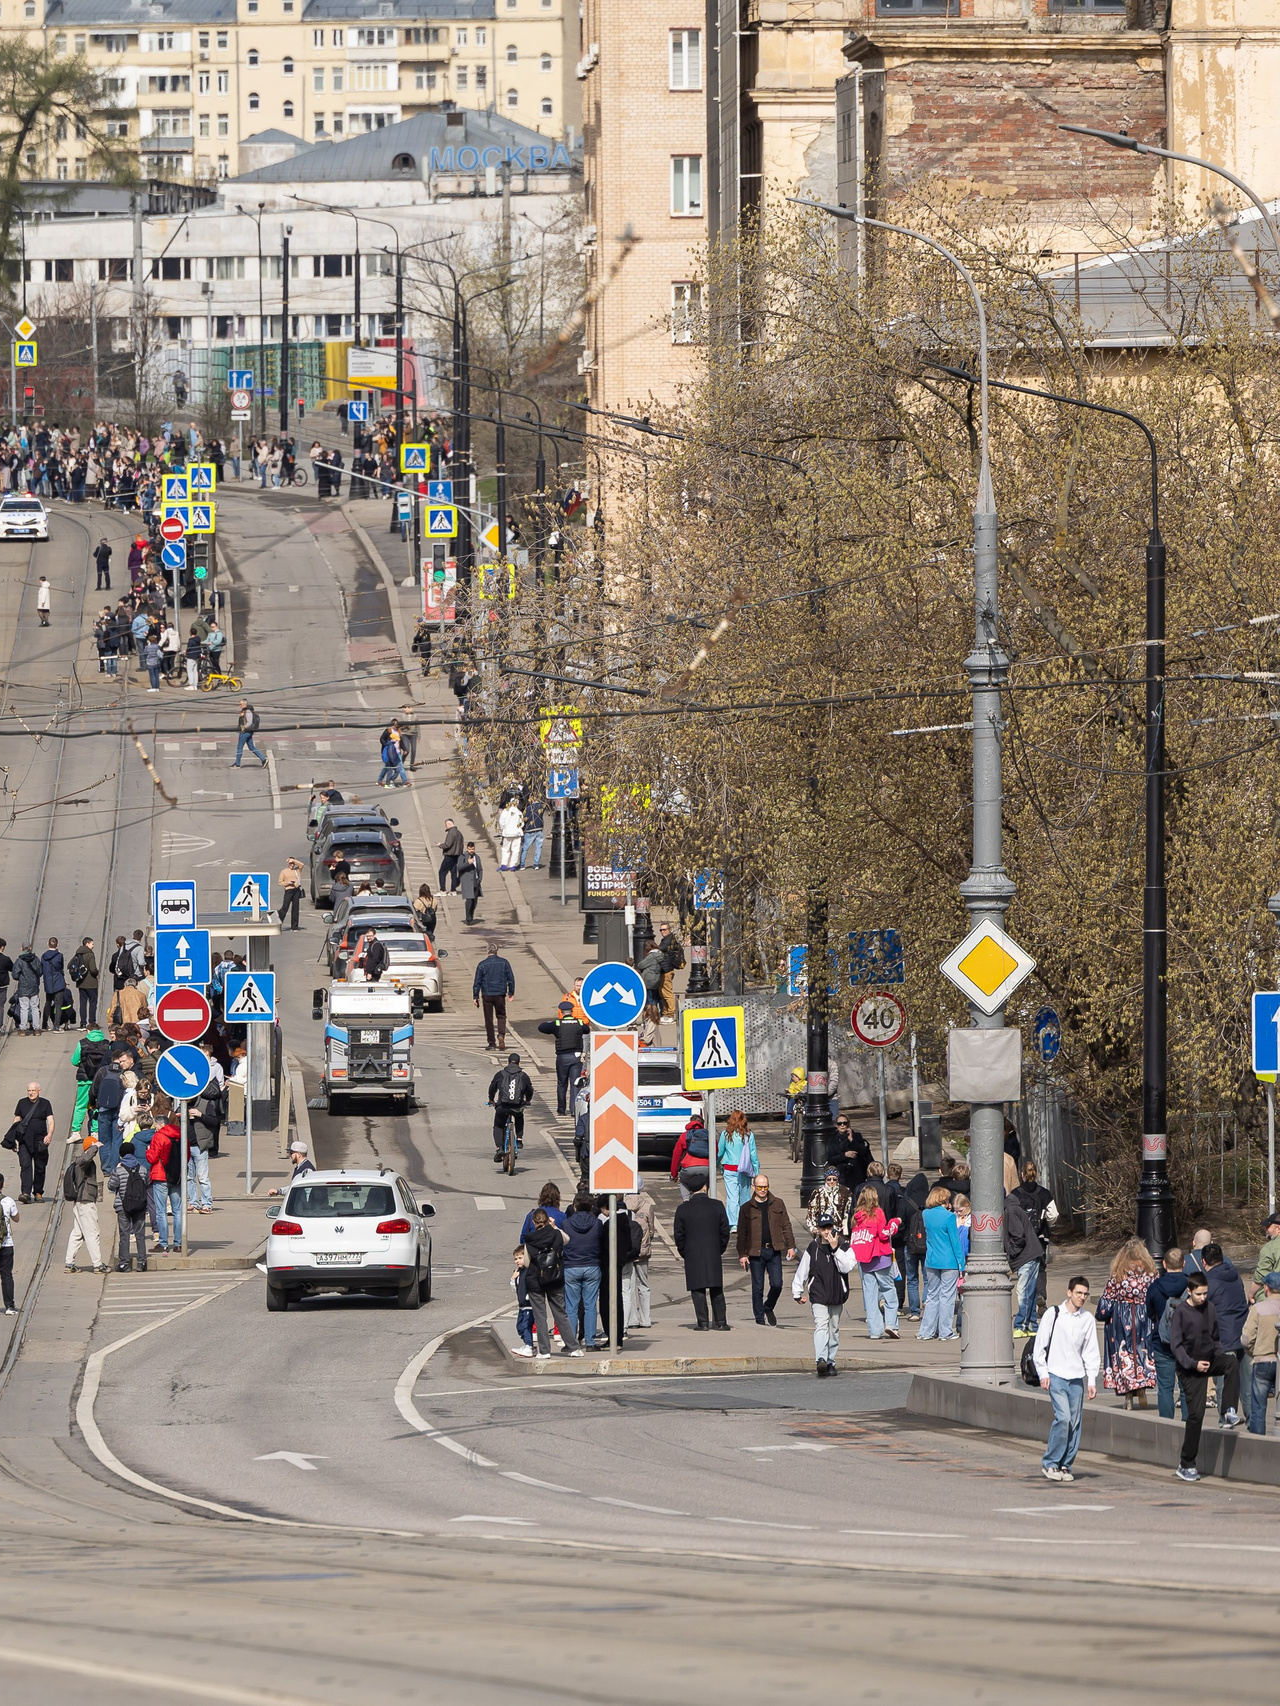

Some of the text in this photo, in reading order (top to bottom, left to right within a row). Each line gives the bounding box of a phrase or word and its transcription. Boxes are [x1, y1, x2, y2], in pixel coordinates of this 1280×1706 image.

[430, 145, 571, 171] МОСКВА
[587, 865, 612, 873] ВОЗЬ
[587, 873, 625, 881] СОБАКУ
[587, 881, 600, 889] ИЗ
[863, 1009, 894, 1029] 40
